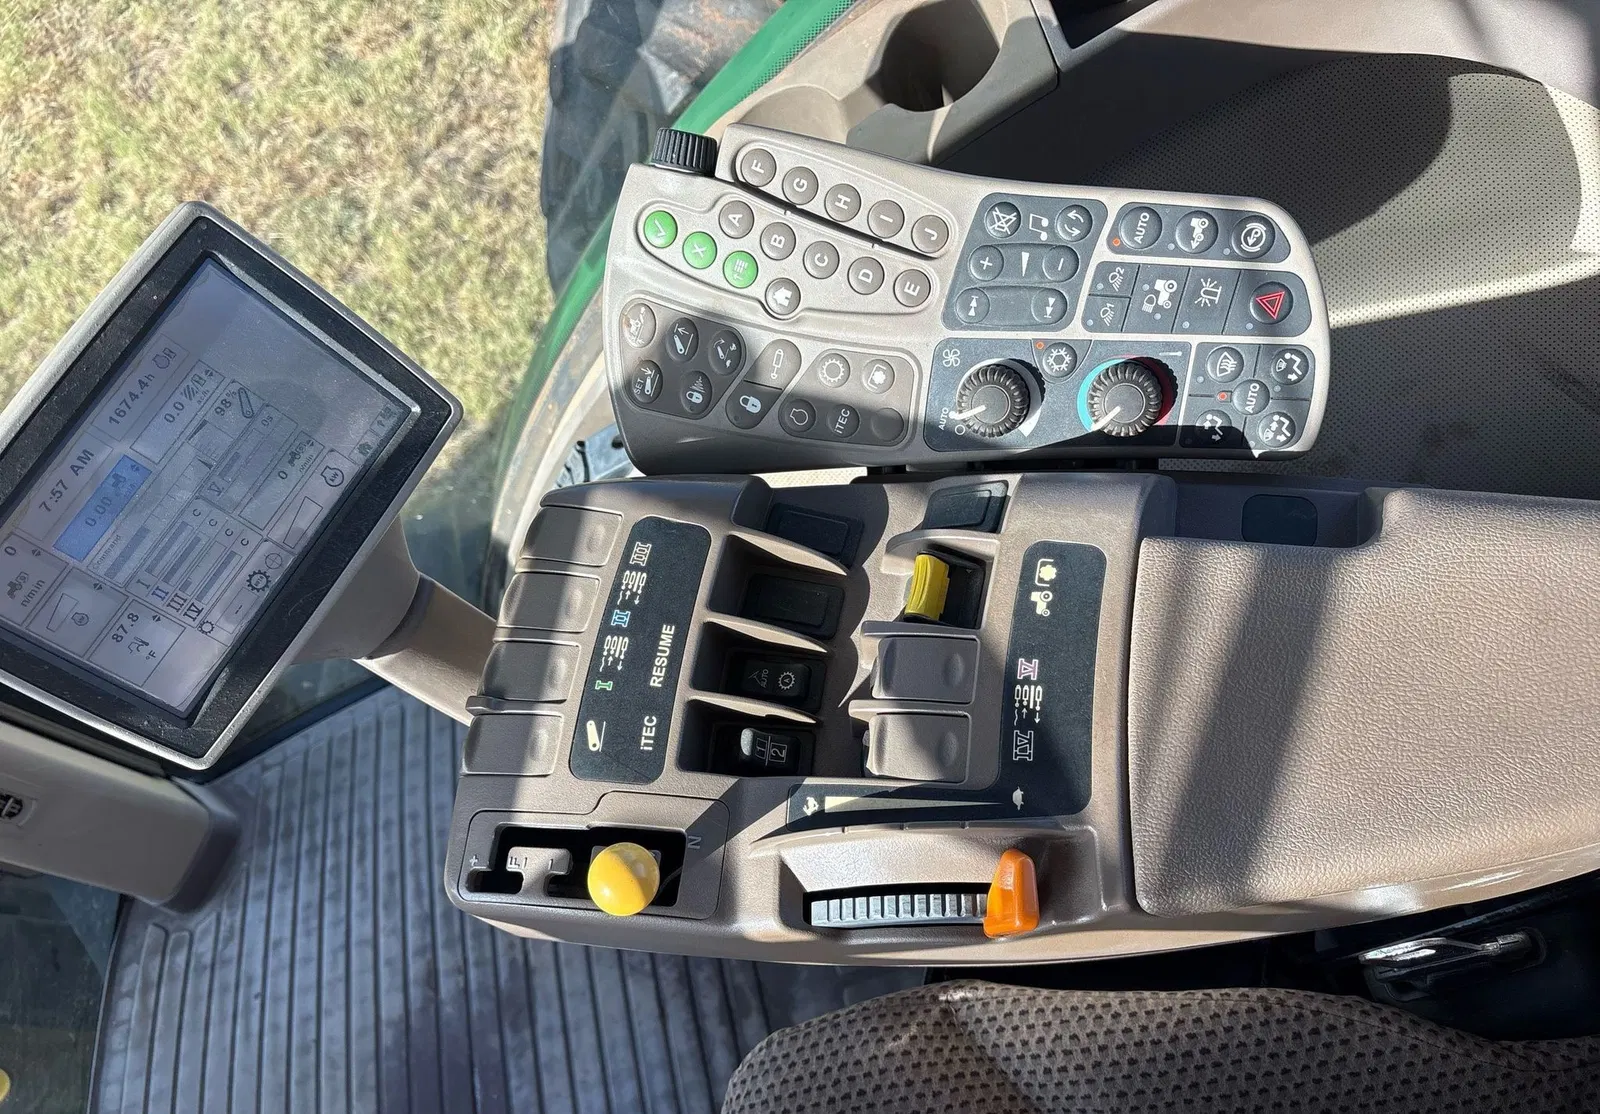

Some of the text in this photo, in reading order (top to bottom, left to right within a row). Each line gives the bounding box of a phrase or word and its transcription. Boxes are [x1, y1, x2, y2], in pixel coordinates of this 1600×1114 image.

[751, 159, 764, 173] F
[793, 178, 808, 192] G
[835, 195, 851, 210] H
[729, 213, 743, 227] A
[1134, 212, 1150, 243] AUTO
[771, 234, 785, 248] B
[923, 229, 938, 241] J
[814, 253, 829, 267] C
[858, 269, 873, 283] D
[905, 281, 921, 297] E
[634, 378, 645, 395] SET
[1245, 382, 1260, 413] AUTO
[164, 402, 185, 423] 0.0
[938, 407, 949, 431] AUTO
[835, 409, 850, 434] iTEC
[39, 449, 94, 512] 7:57 AM
[5, 546, 16, 556] 0
[20, 579, 45, 607] n/min
[112, 612, 139, 642] 87.8
[650, 624, 675, 687] RESUME
[640, 716, 657, 750] iTEC
[688, 835, 702, 850] N
